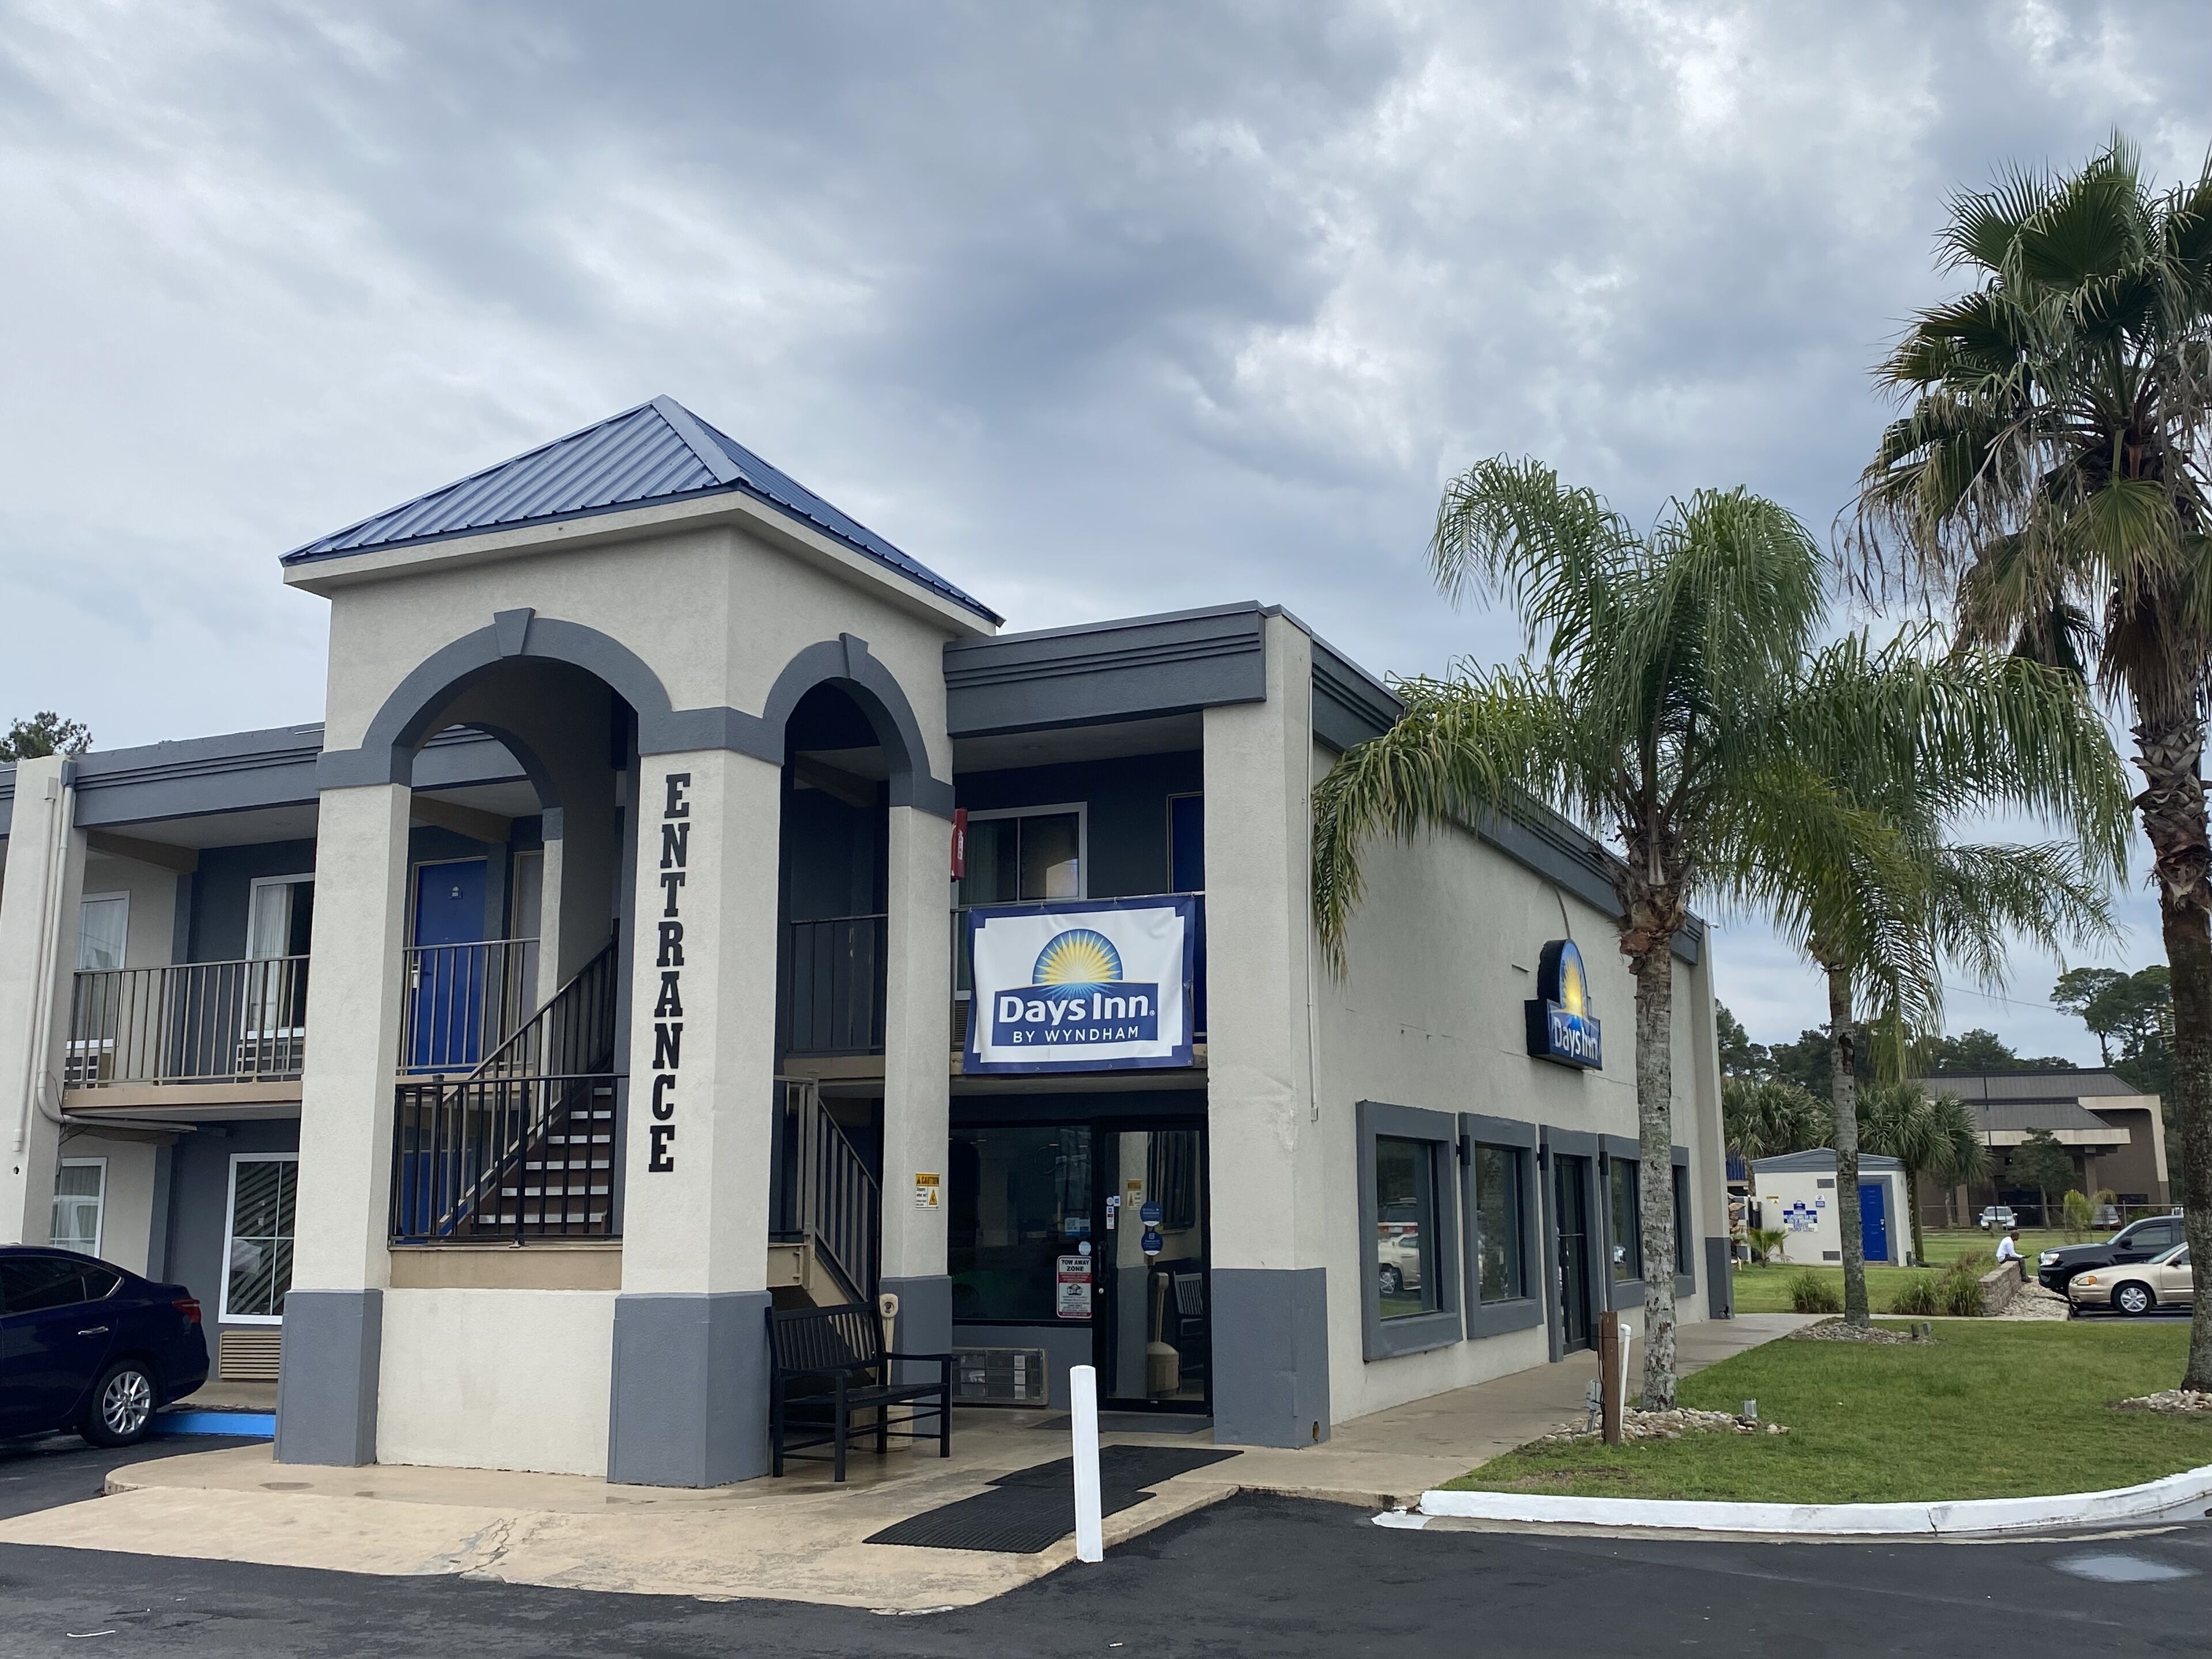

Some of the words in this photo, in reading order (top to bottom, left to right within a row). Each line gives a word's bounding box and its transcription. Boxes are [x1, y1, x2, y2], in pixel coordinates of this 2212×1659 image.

[649, 772, 691, 1172] ENTRANCE
[999, 996, 1086, 1026] Days
[1093, 993, 1149, 1020] Inn
[1013, 1030, 1035, 1043] BY
[1045, 1025, 1138, 1042] WYNDHAM
[1554, 1016, 1581, 1058] Days
[1581, 1027, 1599, 1060] Inn
